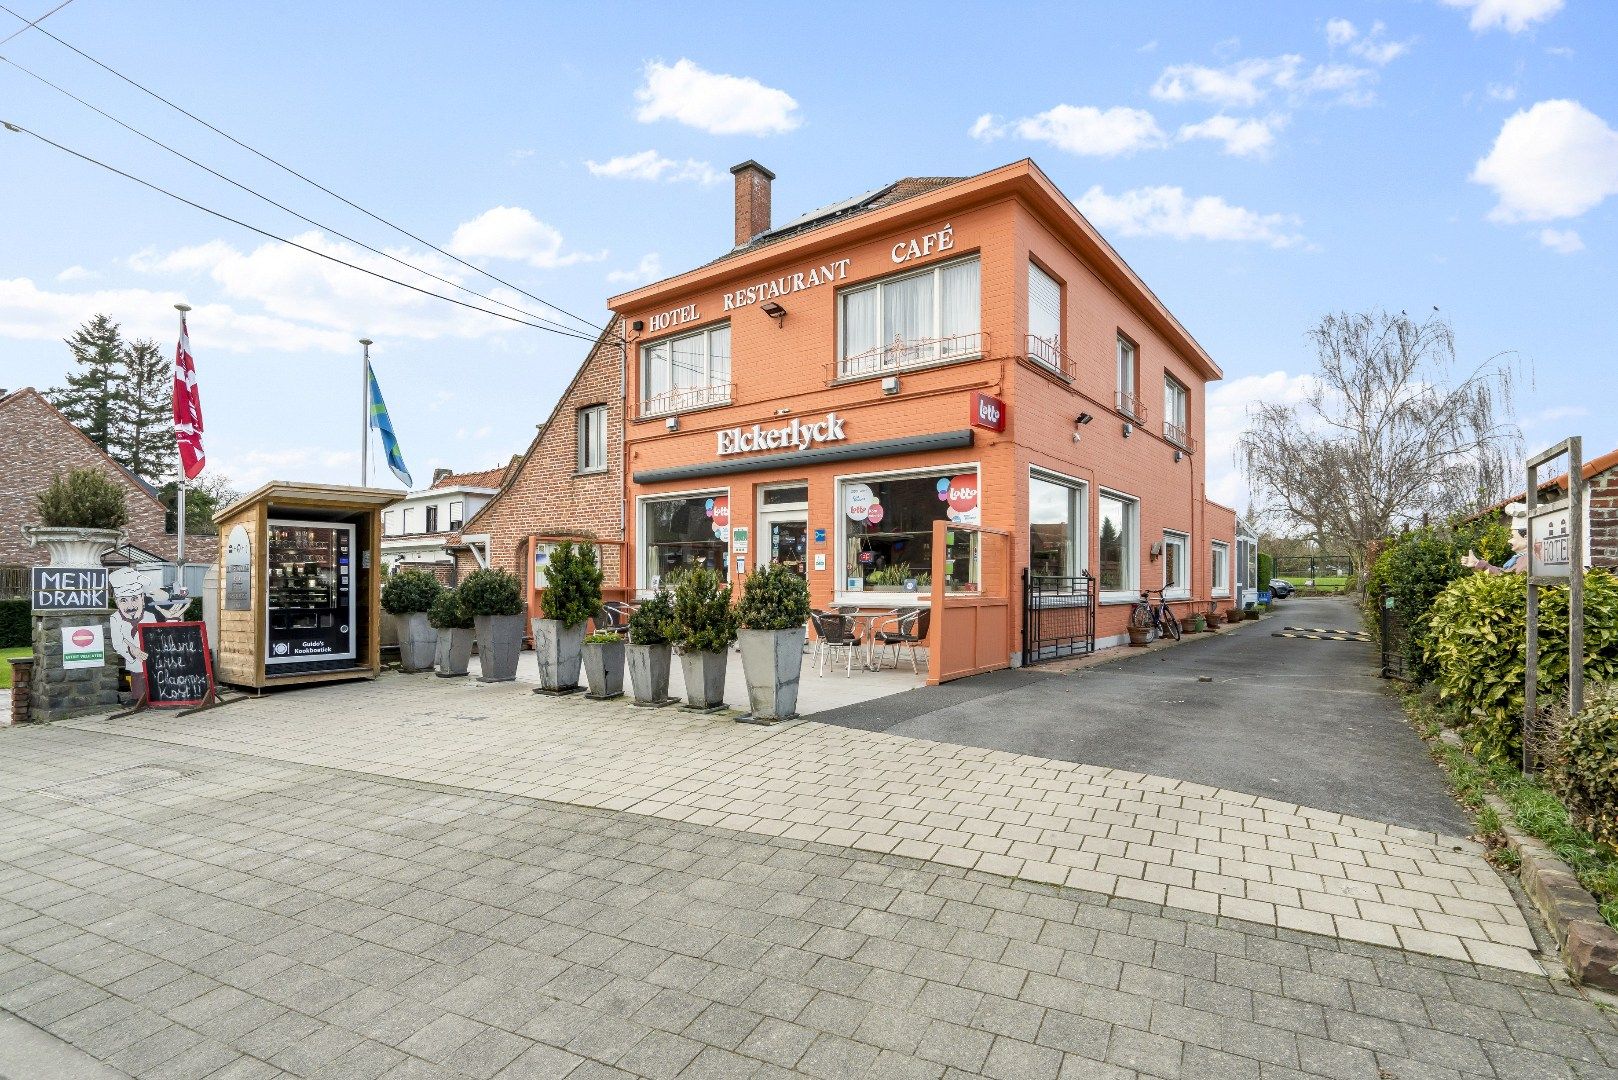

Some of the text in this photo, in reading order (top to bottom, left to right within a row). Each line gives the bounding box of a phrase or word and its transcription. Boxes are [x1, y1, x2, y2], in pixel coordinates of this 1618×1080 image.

[648, 222, 954, 333] HOTEL RESTAURANT CAFÉ
[715, 411, 847, 456] Elckerlyck
[41, 571, 105, 590] MENU
[38, 589, 104, 607] DRANK
[302, 640, 325, 648] Guido's
